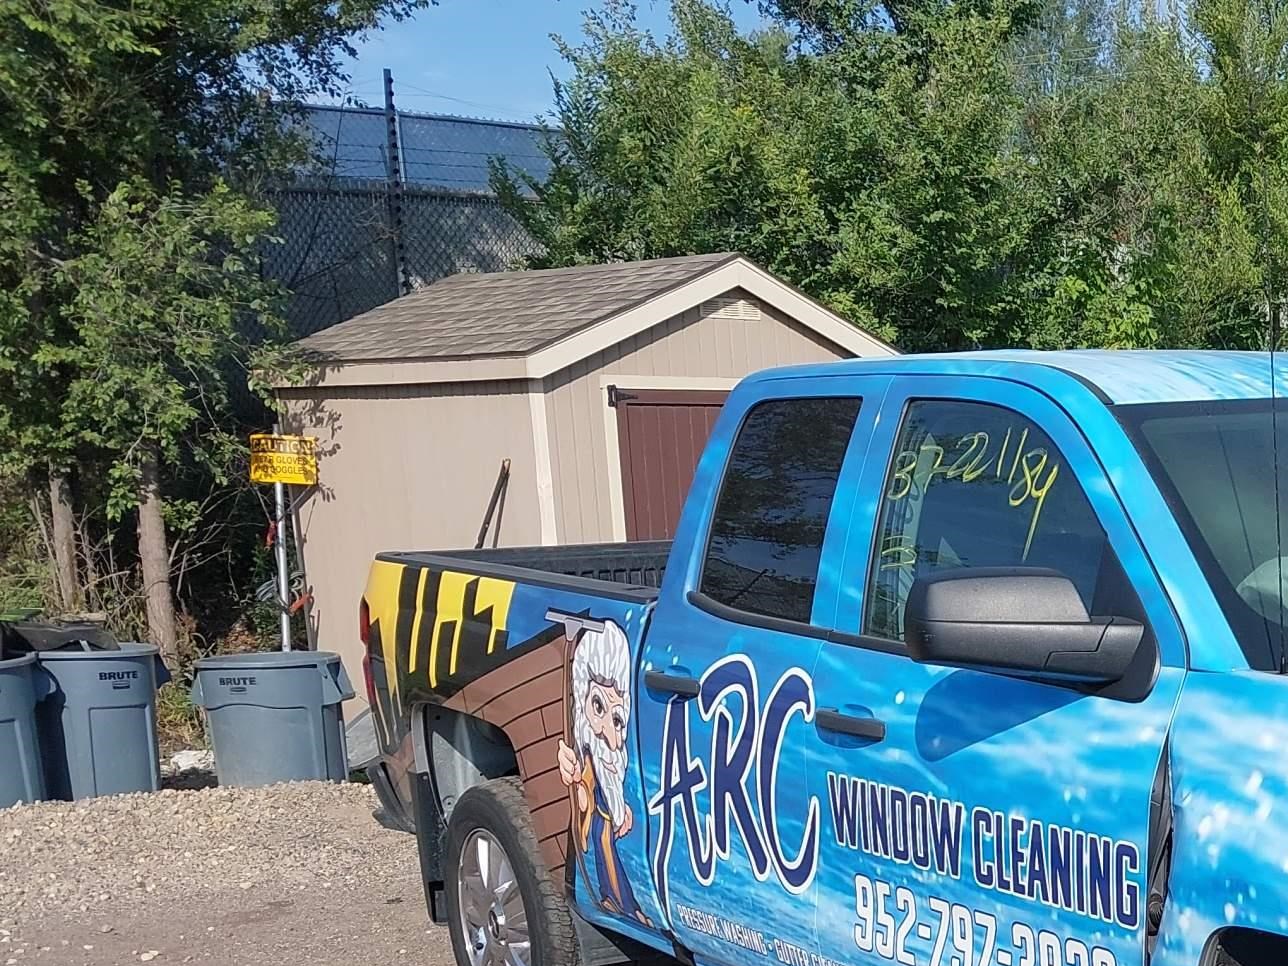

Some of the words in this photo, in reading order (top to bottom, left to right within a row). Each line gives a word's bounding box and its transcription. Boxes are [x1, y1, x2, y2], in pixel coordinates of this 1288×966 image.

[252, 439, 312, 455] CAUTION
[98, 670, 139, 681] BRUTE
[218, 676, 257, 686] BRUTE
[648, 653, 820, 911] ARC
[827, 772, 964, 880] WINDOW
[972, 806, 1140, 931] CLEANING
[676, 903, 723, 939] PRESSURE
[720, 918, 768, 957] WASHING
